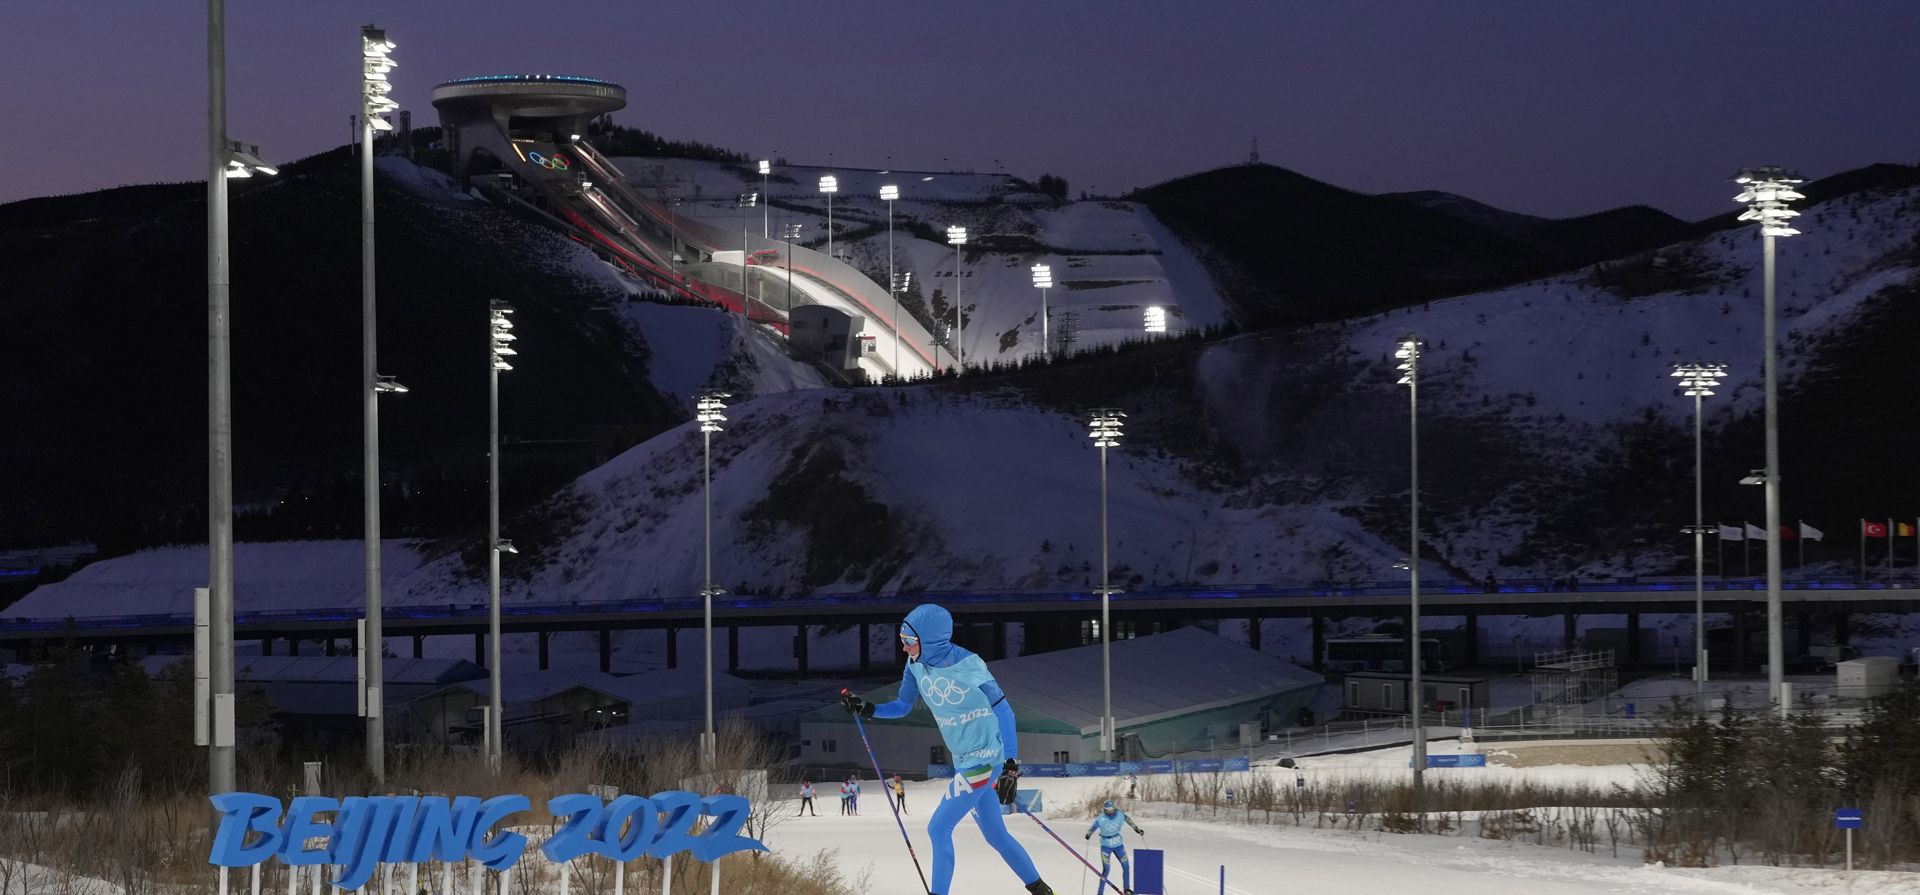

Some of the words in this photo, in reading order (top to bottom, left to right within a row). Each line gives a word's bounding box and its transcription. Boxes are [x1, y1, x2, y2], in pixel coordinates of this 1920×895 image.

[960, 708, 992, 724] 2022
[209, 792, 530, 890] BEIJING
[543, 790, 770, 863] 2022
